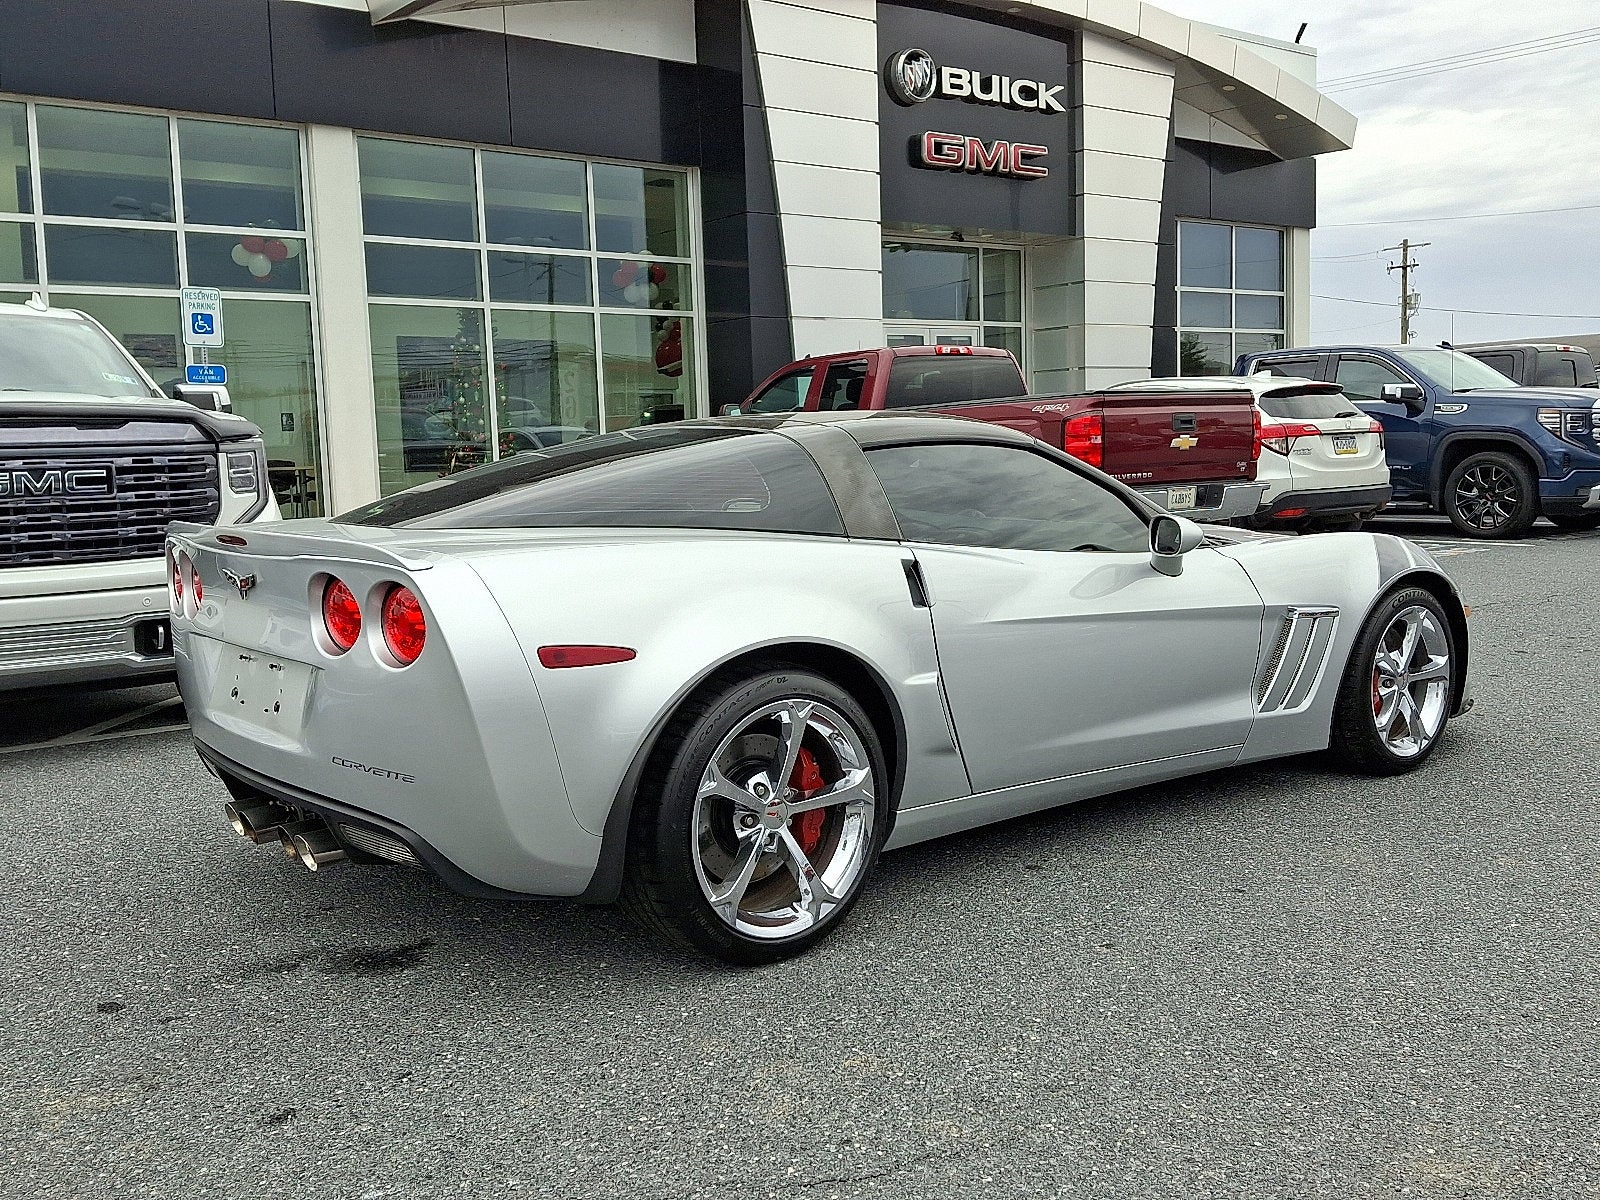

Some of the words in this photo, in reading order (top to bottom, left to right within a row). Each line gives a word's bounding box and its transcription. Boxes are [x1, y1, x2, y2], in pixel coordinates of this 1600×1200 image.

[941, 65, 1067, 112] BUICK
[922, 130, 1049, 177] GMC
[184, 291, 219, 301] RESERVED
[188, 301, 216, 311] PARKING
[0, 469, 108, 496] MC
[331, 756, 416, 784] CORVETTE
